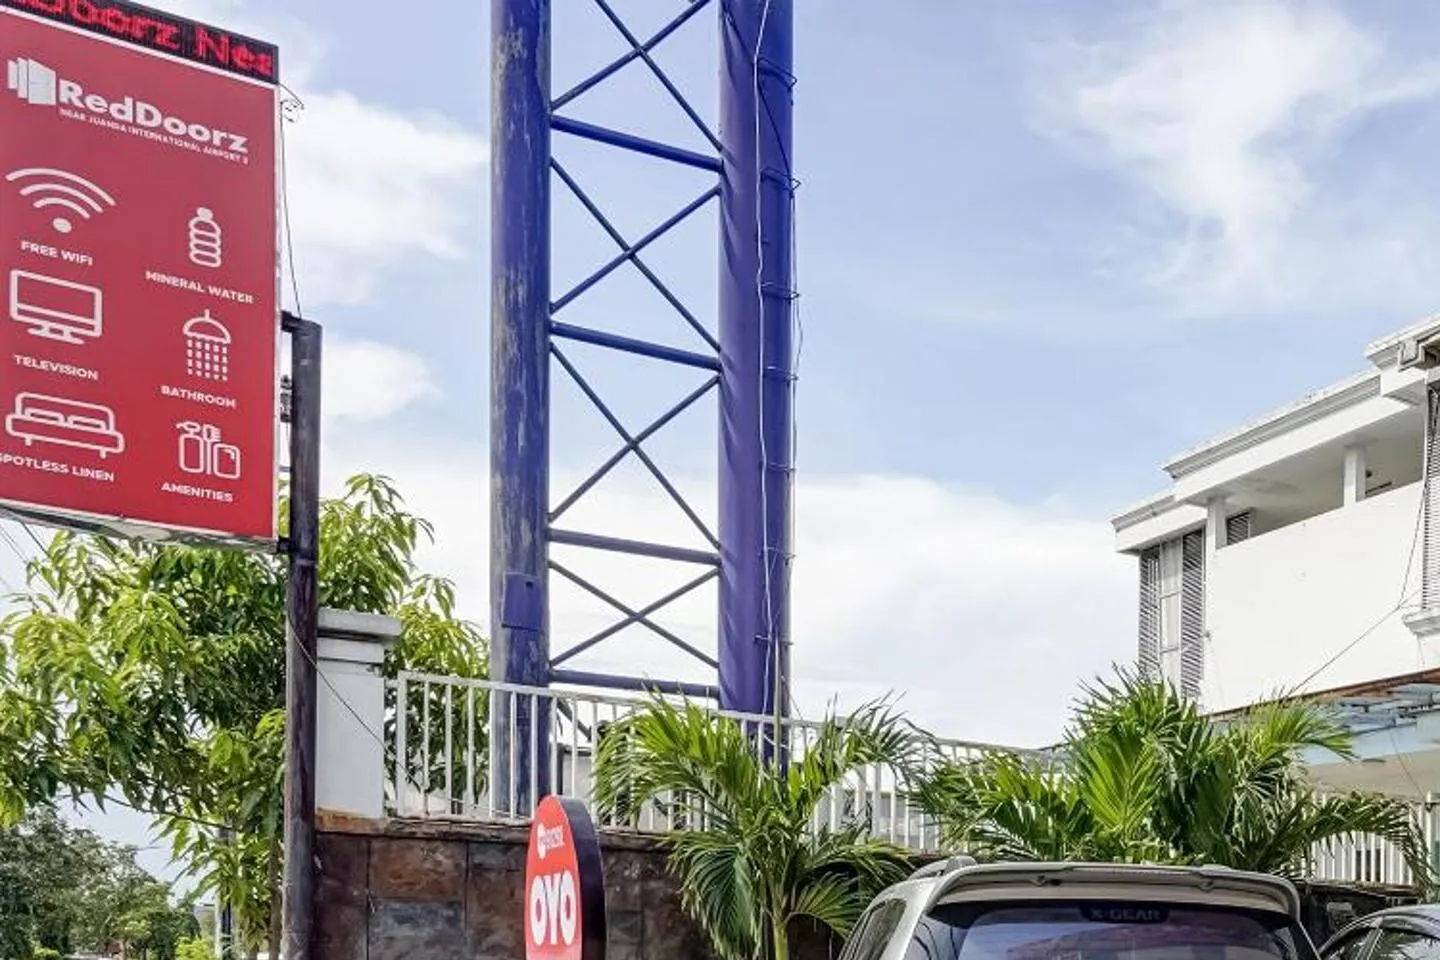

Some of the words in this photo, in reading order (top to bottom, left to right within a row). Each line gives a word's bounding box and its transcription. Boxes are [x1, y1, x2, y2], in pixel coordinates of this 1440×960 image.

[58, 78, 248, 154] RedDoorz
[21, 240, 58, 258] FREE
[61, 250, 94, 266] WIFI
[145, 270, 205, 293] MINERAL
[208, 285, 254, 304] WATER
[14, 354, 98, 380] TELEVISION
[161, 385, 236, 408] BATHROOM
[72, 466, 114, 482] LINEN
[161, 482, 233, 502] AMENITIES
[530, 870, 577, 946] OYO
[1090, 907, 1161, 922] X-GEAR
